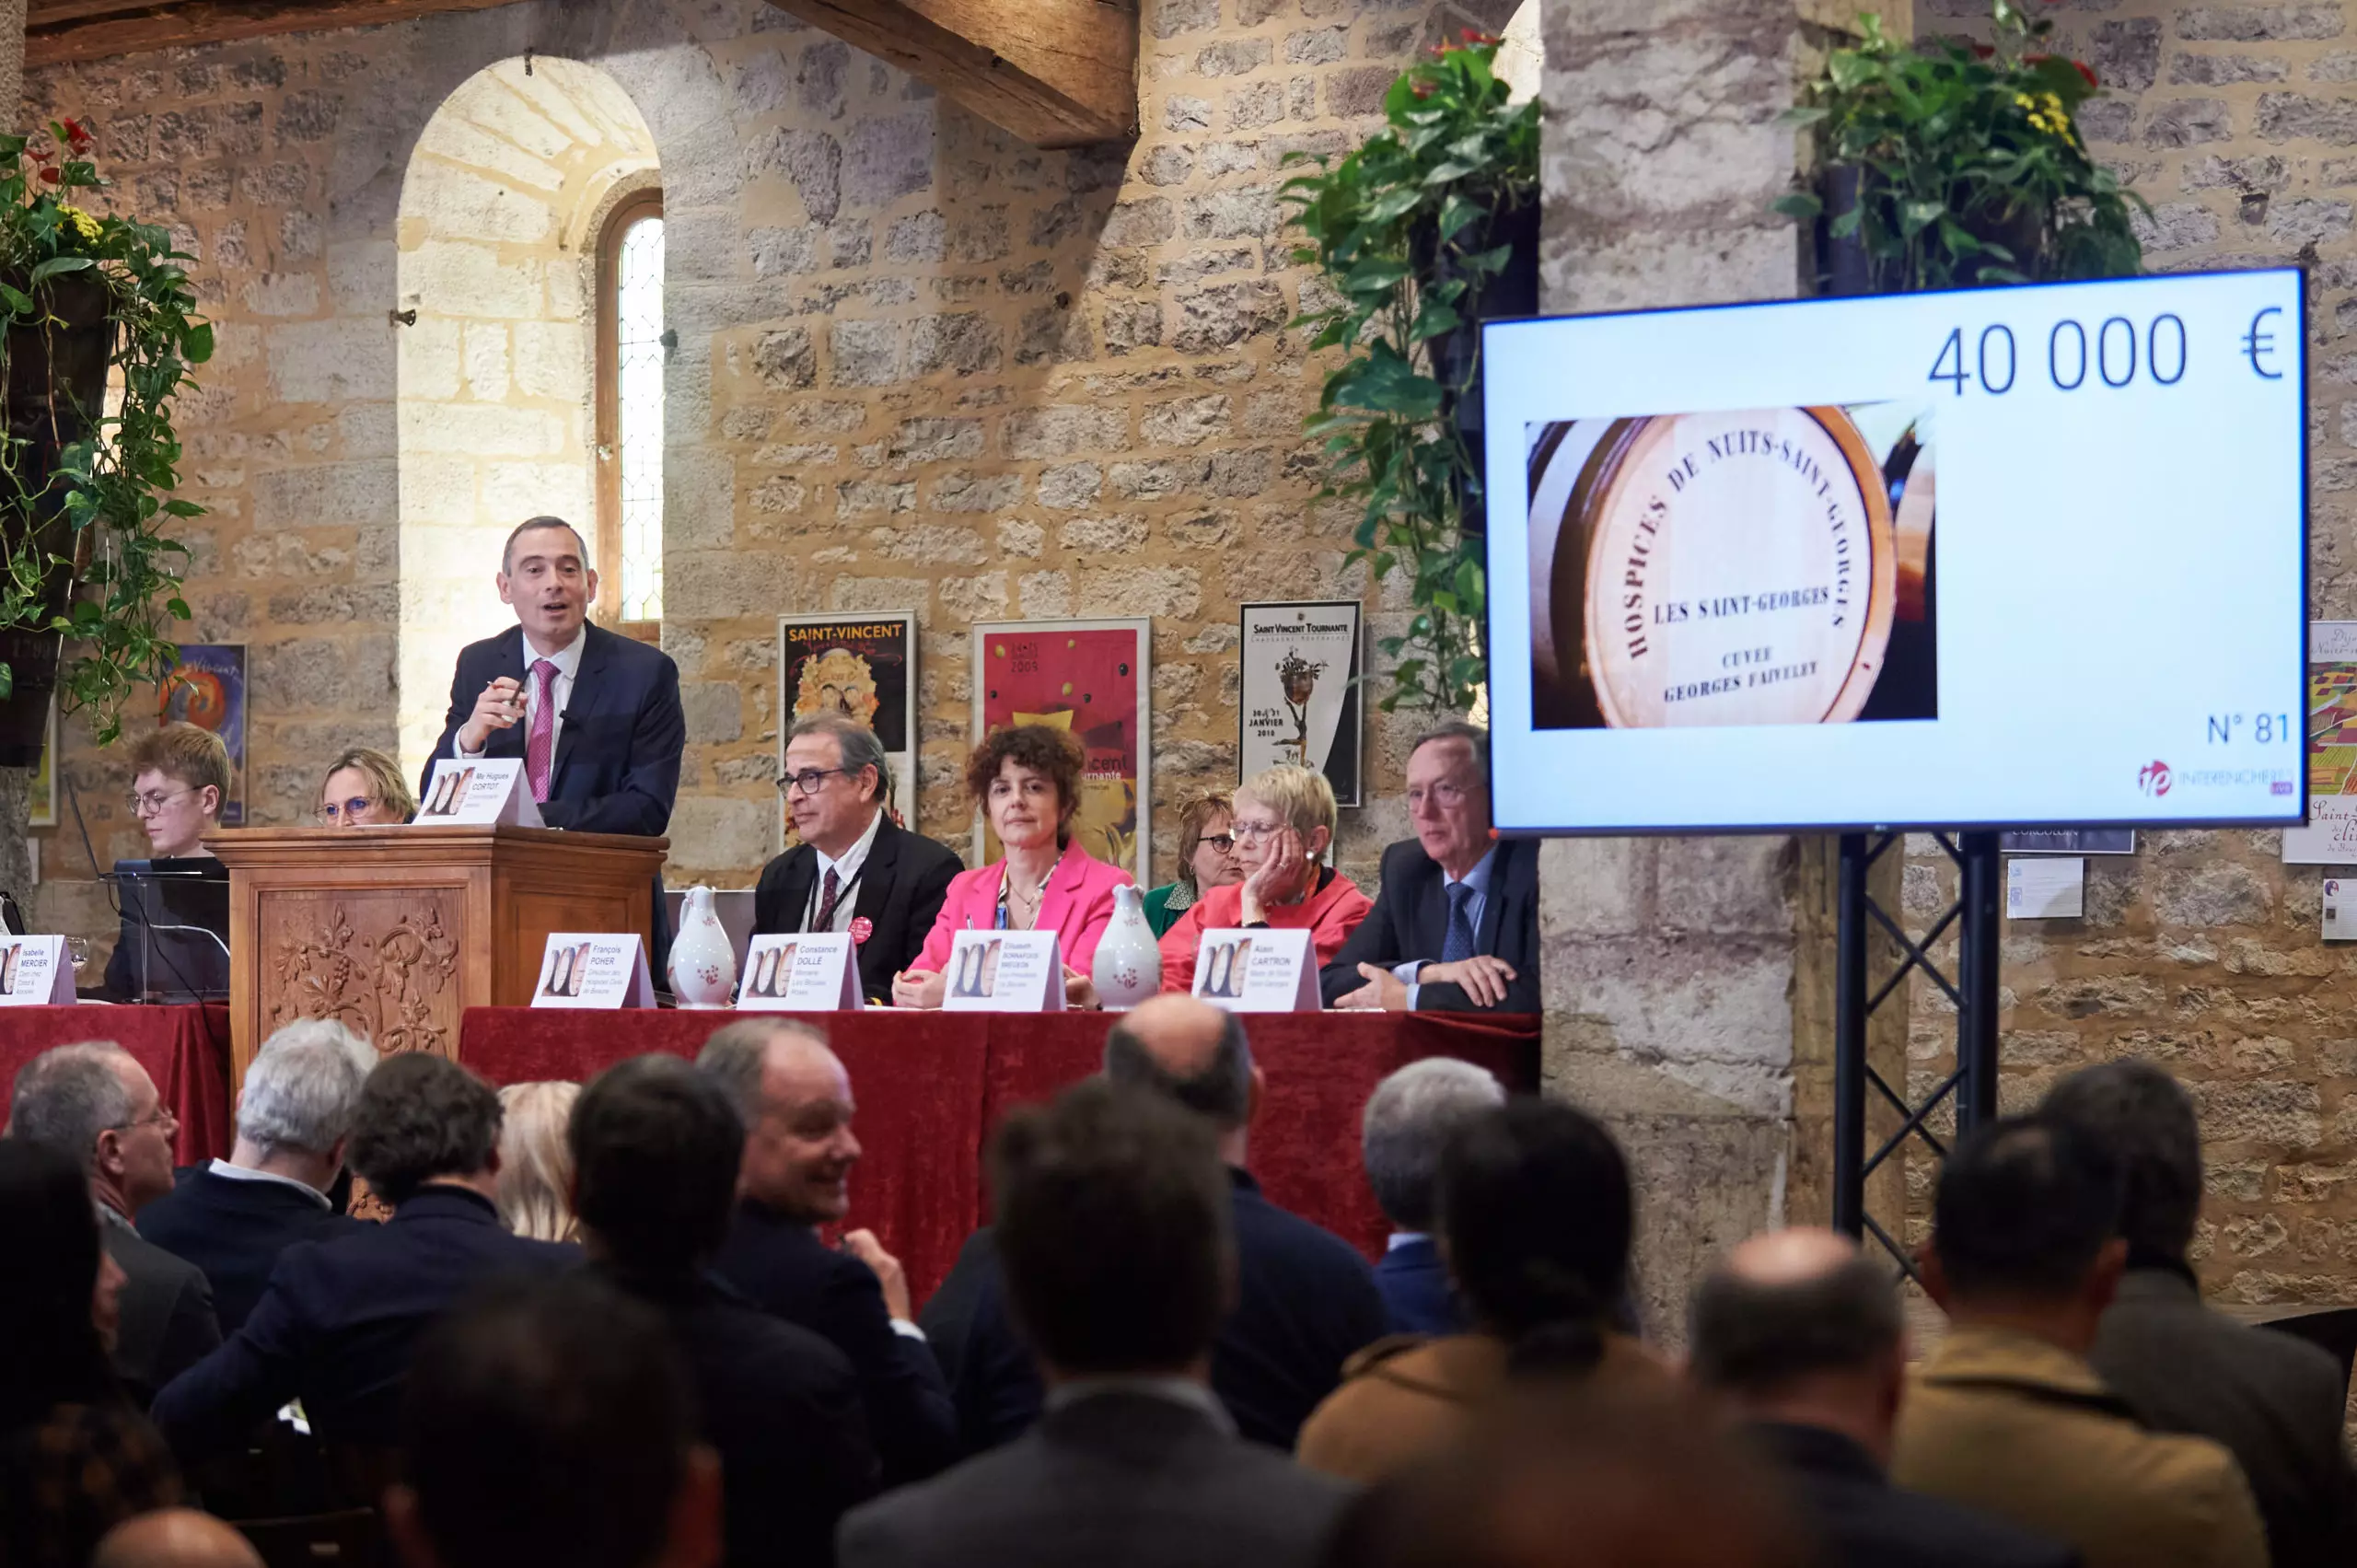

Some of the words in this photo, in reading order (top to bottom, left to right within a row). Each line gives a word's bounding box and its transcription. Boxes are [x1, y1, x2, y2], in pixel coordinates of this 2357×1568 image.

[1928, 324, 2016, 397] 40
[2049, 313, 2187, 391] 000
[2240, 307, 2282, 379] €
[1623, 495, 1667, 661] HOSPICES
[1666, 451, 1700, 494] DE
[1706, 429, 1852, 629] NUITS-SAINT-GEORGES
[1654, 600, 1689, 625] LES
[1699, 586, 1829, 618] SAINT-GEORGES
[789, 624, 902, 642] SAINT-VINCENT
[1253, 623, 1274, 634] SAINT
[1275, 622, 1305, 633] VINCENT
[1306, 621, 1348, 633] TOURNANTE
[1722, 646, 1773, 669] CUVEE
[1664, 677, 1741, 703] GEORGES
[1747, 660, 1818, 688] FAIVELEY
[1248, 718, 1283, 727] JANVIER
[2255, 713, 2288, 743] 81
[22, 948, 44, 957] Isabelle
[593, 945, 621, 955] François
[800, 945, 838, 954] Constance
[21, 958, 48, 967] MERCIER
[590, 957, 615, 965] POHER
[1251, 957, 1291, 966] CARTRON
